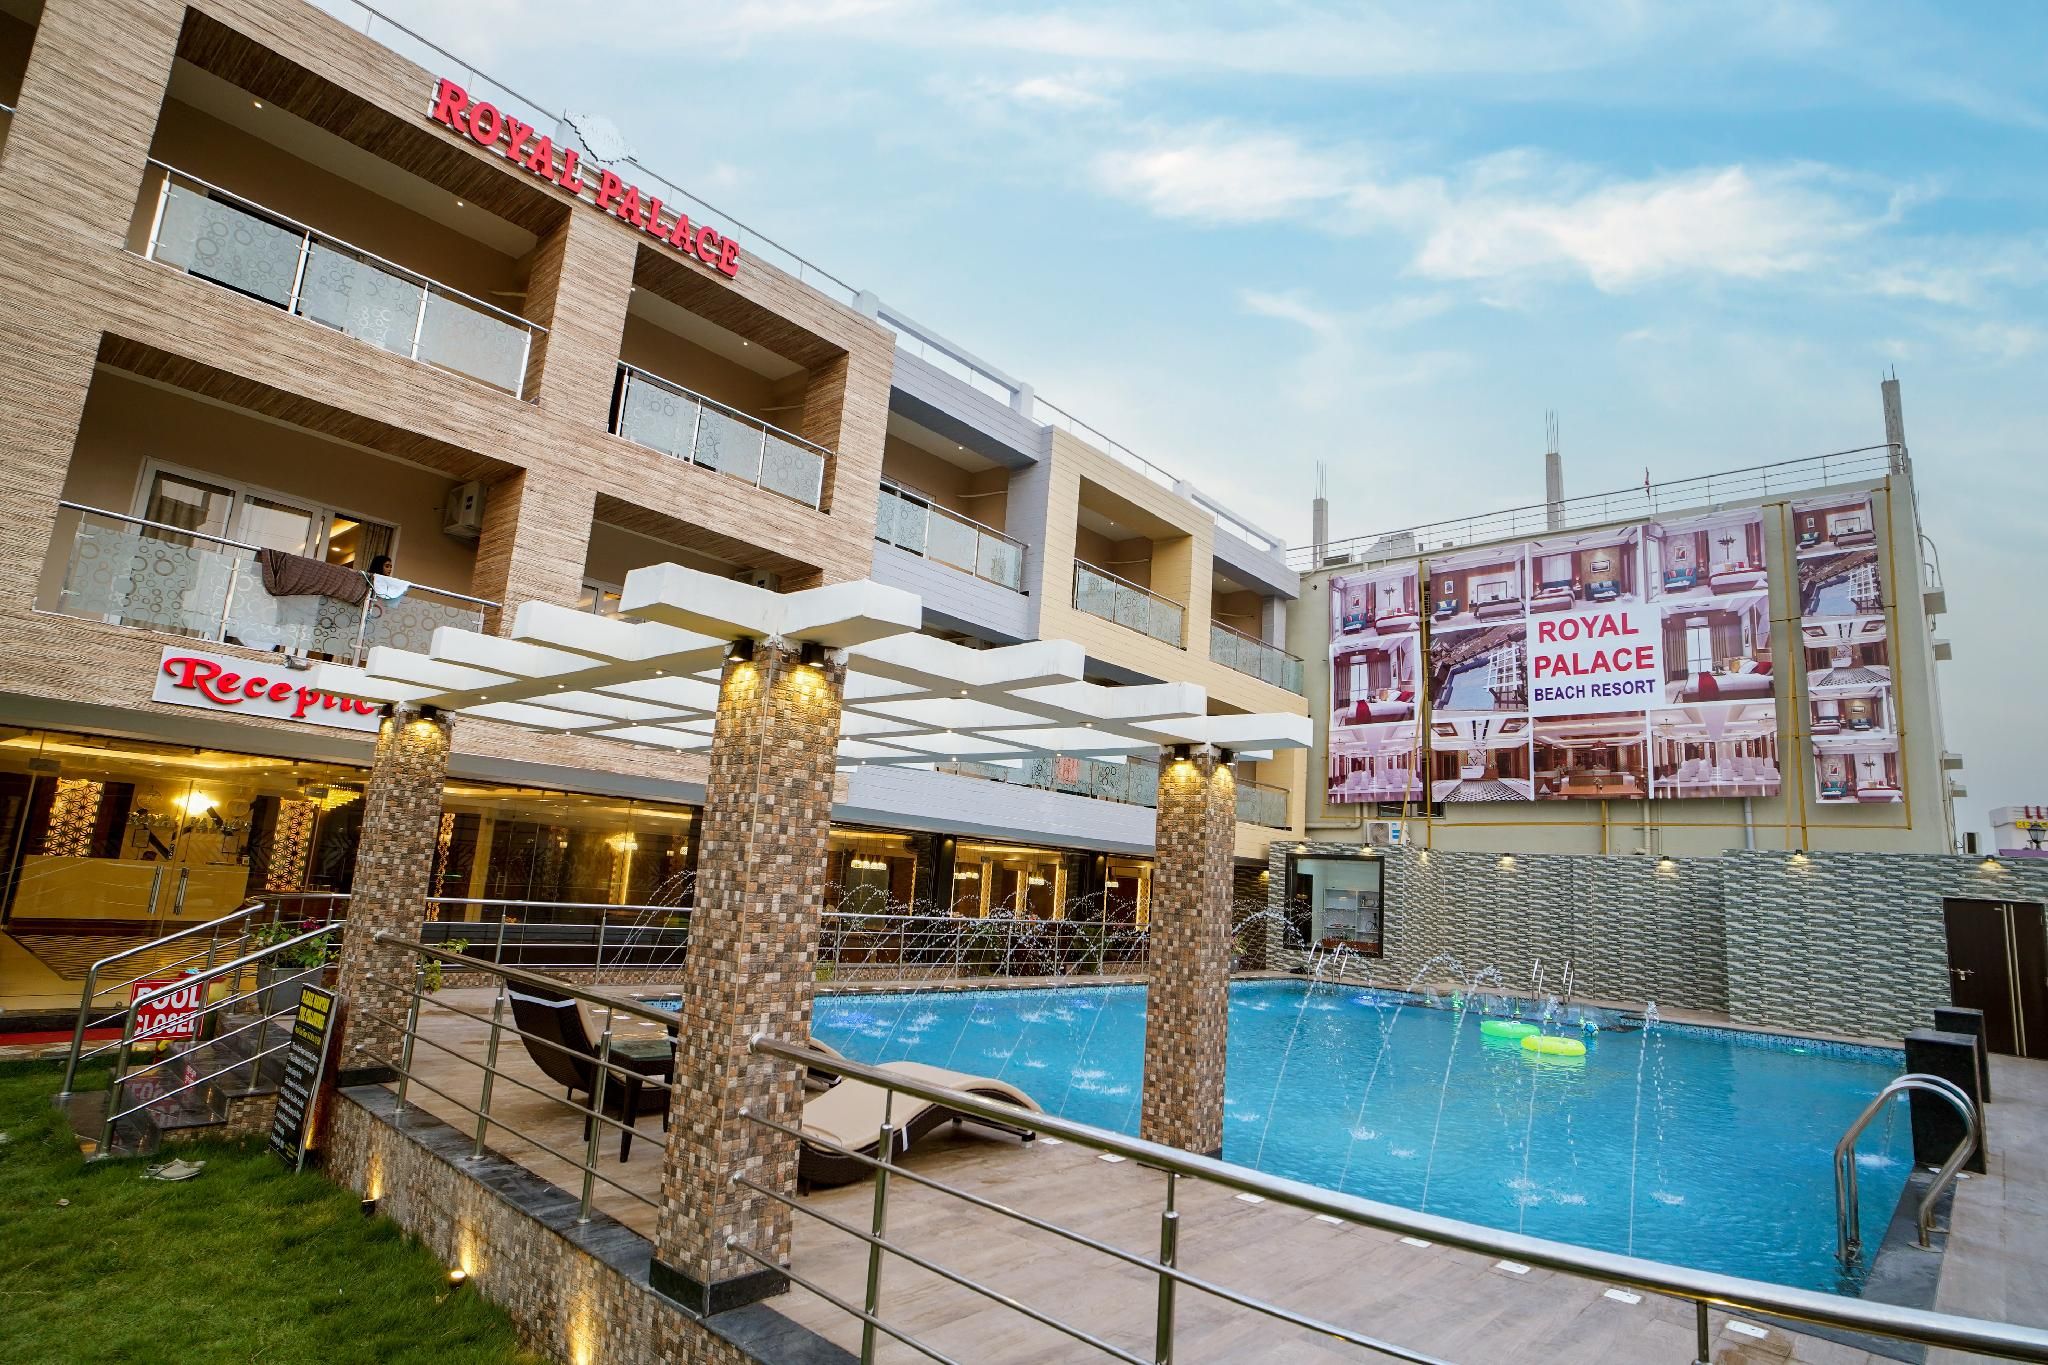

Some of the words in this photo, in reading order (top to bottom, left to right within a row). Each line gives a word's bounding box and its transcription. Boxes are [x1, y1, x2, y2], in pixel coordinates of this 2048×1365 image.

[433, 77, 583, 194] ROYAL
[596, 168, 740, 278] PALACE
[1538, 612, 1639, 644] ROYAL
[1534, 645, 1655, 679] PALACE
[1534, 684, 1586, 701] BEACH
[1591, 679, 1656, 697] RESORT
